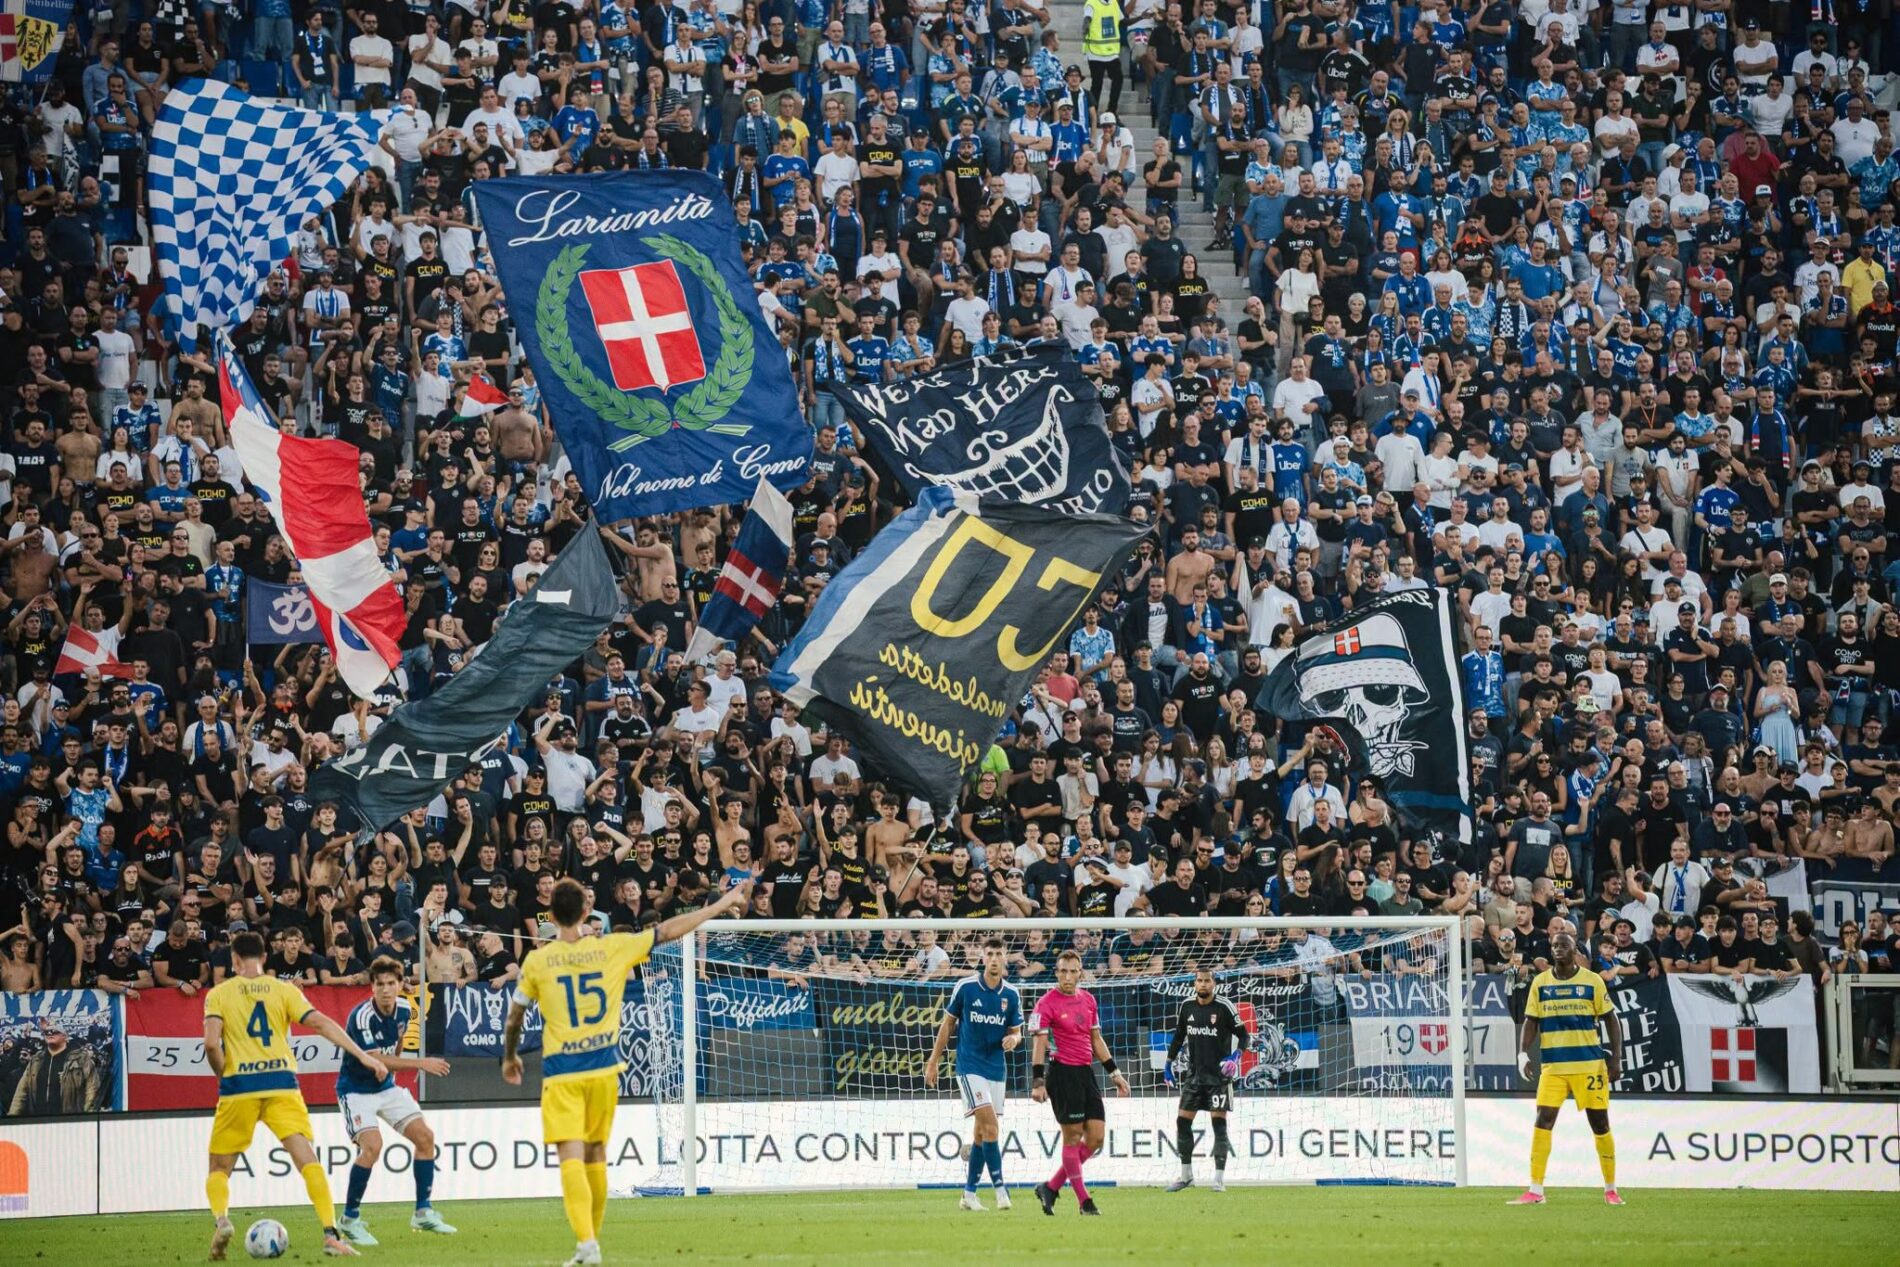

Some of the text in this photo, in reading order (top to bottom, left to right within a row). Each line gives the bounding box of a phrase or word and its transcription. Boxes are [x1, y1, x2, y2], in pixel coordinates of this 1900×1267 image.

[1327, 67, 1349, 79] Uber
[869, 152, 894, 161] COMO
[508, 190, 714, 247] Larianità
[1866, 322, 1895, 332] Revolut
[857, 357, 881, 367] Uber
[1175, 393, 1199, 403] Uber
[1278, 460, 1301, 471] Uber
[592, 463, 631, 505] Nel
[635, 473, 695, 496] nome
[700, 459, 724, 486] di
[732, 443, 807, 481] Como
[198, 490, 226, 500] COMO
[1240, 498, 1267, 509] COMO
[1565, 653, 1588, 662] COMO
[1835, 648, 1861, 658] COMO
[524, 801, 550, 811] COMO
[1237, 977, 1305, 997] Lariana
[557, 972, 607, 1028] 15
[706, 990, 808, 1028] Diffidati
[246, 1001, 274, 1047] 4
[1186, 1025, 1218, 1036] Revolut
[561, 1031, 614, 1052] MOBY
[1381, 1024, 1415, 1055] 19
[146, 1045, 178, 1068] 25
[238, 1058, 290, 1072] MOBY
[1586, 1075, 1604, 1090] 23
[1212, 1094, 1227, 1109] 97
[795, 1131, 963, 1162] CONTRO
[1250, 1129, 1283, 1158] DI
[1299, 1129, 1456, 1158] GENERE
[1648, 1132, 1676, 1160] A
